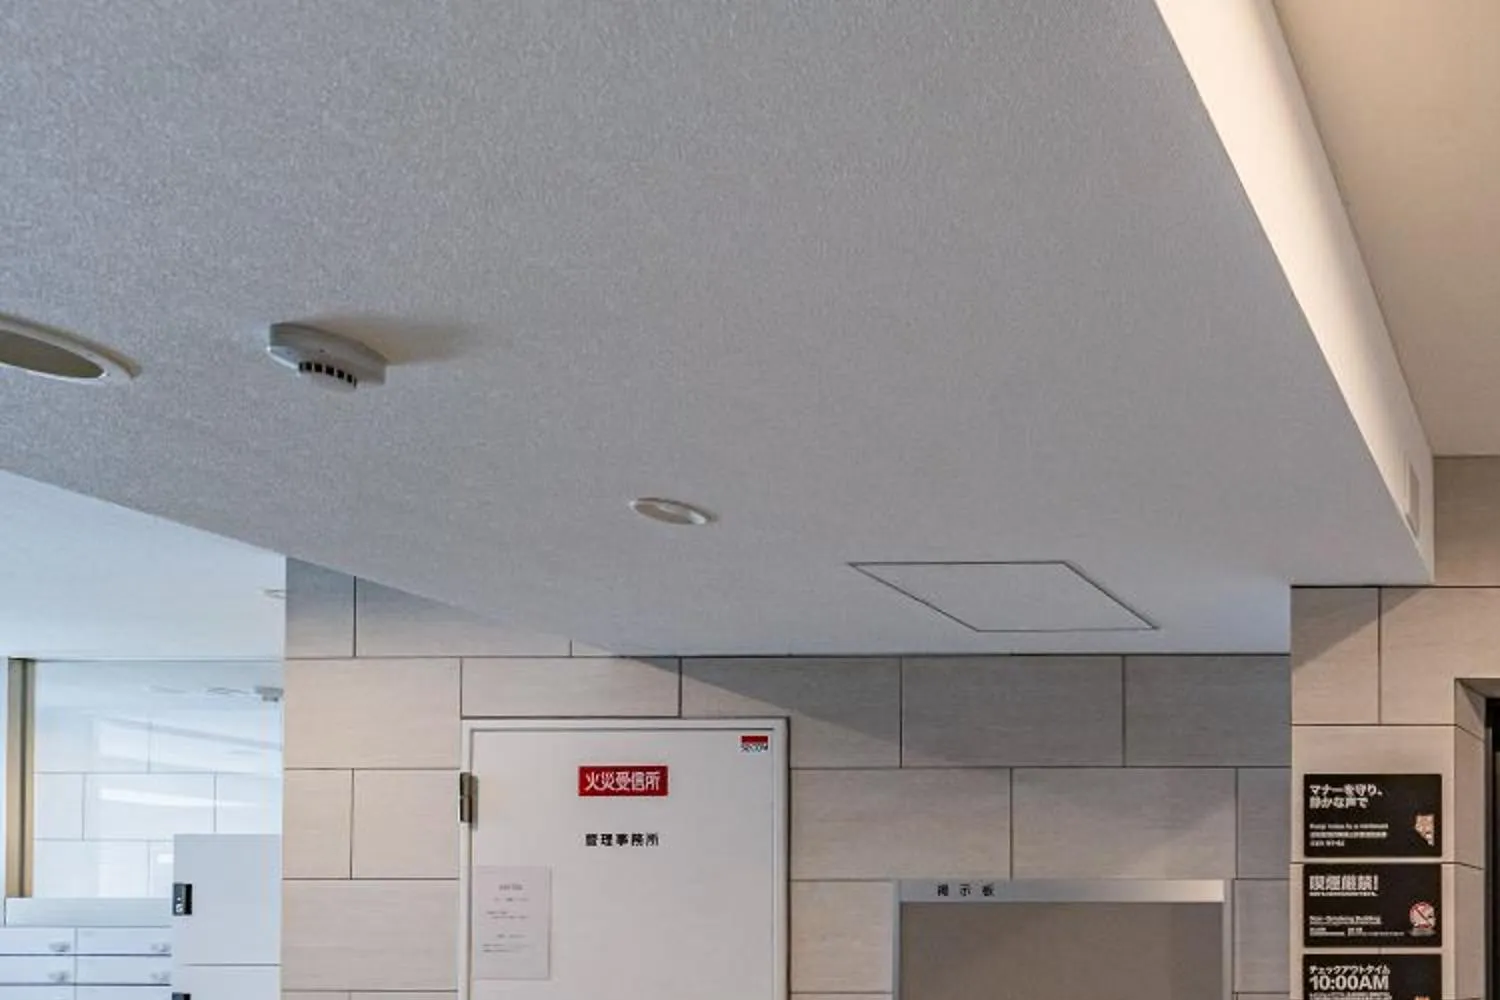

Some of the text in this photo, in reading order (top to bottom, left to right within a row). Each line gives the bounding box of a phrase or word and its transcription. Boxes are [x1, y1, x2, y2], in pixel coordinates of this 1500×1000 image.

[585, 770, 660, 791] 火災受信所
[937, 883, 995, 897] 掲示板
[1309, 965, 1391, 975] チェックアウトタイム
[1309, 975, 1389, 991] 10:00AM
